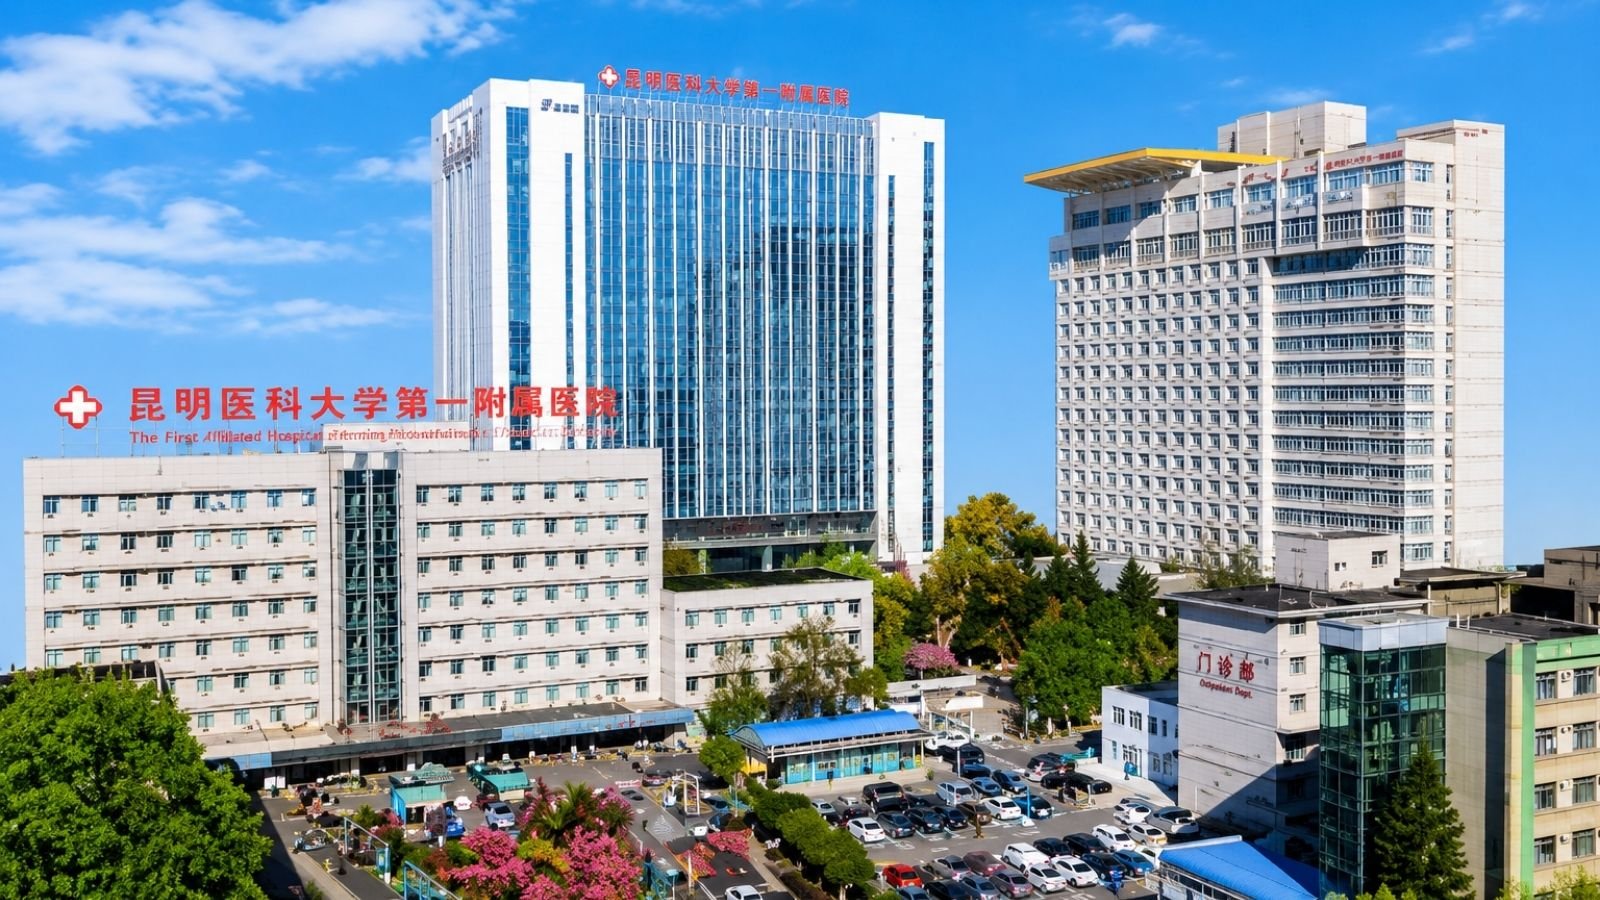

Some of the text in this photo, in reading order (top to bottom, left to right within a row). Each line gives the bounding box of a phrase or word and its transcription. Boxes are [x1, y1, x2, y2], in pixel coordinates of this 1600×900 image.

[625, 69, 849, 106] 昆明医科大学第一附属医院
[129, 385, 618, 422] 昆明医科大学第一附属医院
[130, 431, 158, 443] The
[165, 431, 198, 443] First
[1196, 651, 1254, 683] 门诊部
